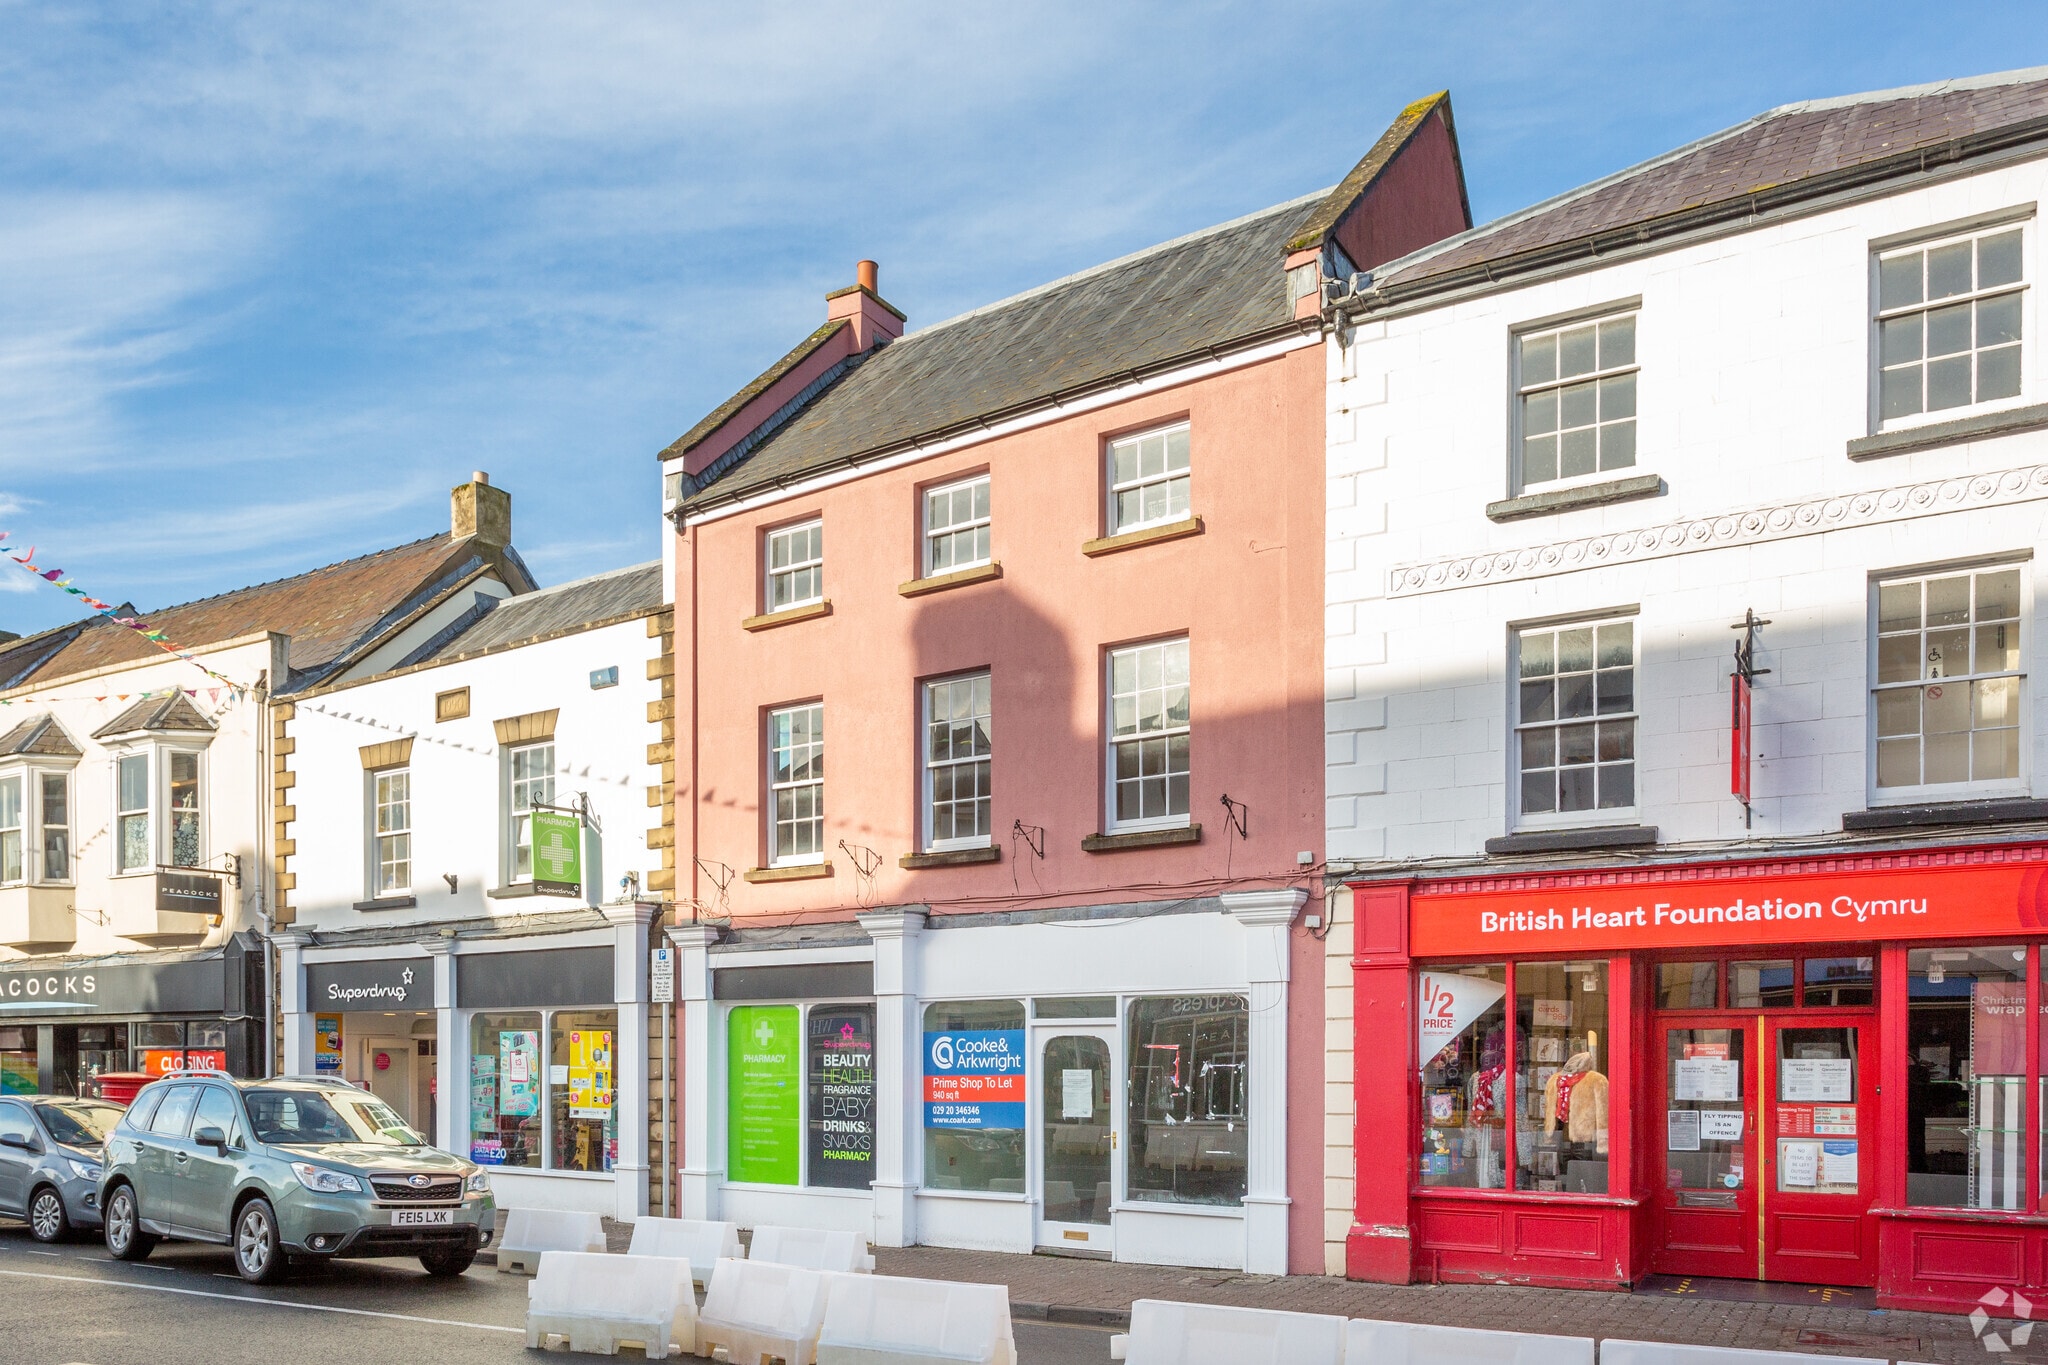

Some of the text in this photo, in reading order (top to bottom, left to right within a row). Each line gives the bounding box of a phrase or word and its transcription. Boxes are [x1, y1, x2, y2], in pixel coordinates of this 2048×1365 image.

[536, 816, 576, 828] PHARMACY
[161, 887, 219, 898] PEACOCKS
[537, 885, 576, 896] Superdrug
[1481, 895, 1928, 933] British Heart Foundation Cymru
[328, 983, 407, 1002] Superdrug
[823, 1039, 871, 1049] Superdrug
[956, 1037, 1008, 1053] Cooke&
[161, 1056, 214, 1071] CLOSING
[743, 1054, 786, 1063] PHARMACY
[823, 1054, 871, 1067] BEAUTY
[956, 1053, 1021, 1071] Arkwright
[823, 1069, 871, 1083] HEALTH
[823, 1085, 871, 1095] FRAGRANCE
[933, 1077, 1013, 1091] Prime Shop To Let
[933, 1091, 960, 1101] 940 sq ft
[823, 1097, 871, 1118] BABY
[933, 1106, 980, 1115] 029 20 346346
[474, 1139, 502, 1147] UNLIMITED
[823, 1134, 871, 1150] SNACKS
[474, 1146, 489, 1154] DATA
[490, 1148, 507, 1159] £20
[823, 1150, 871, 1161] PHARMACY
[398, 1211, 447, 1223] FE15 LXK
